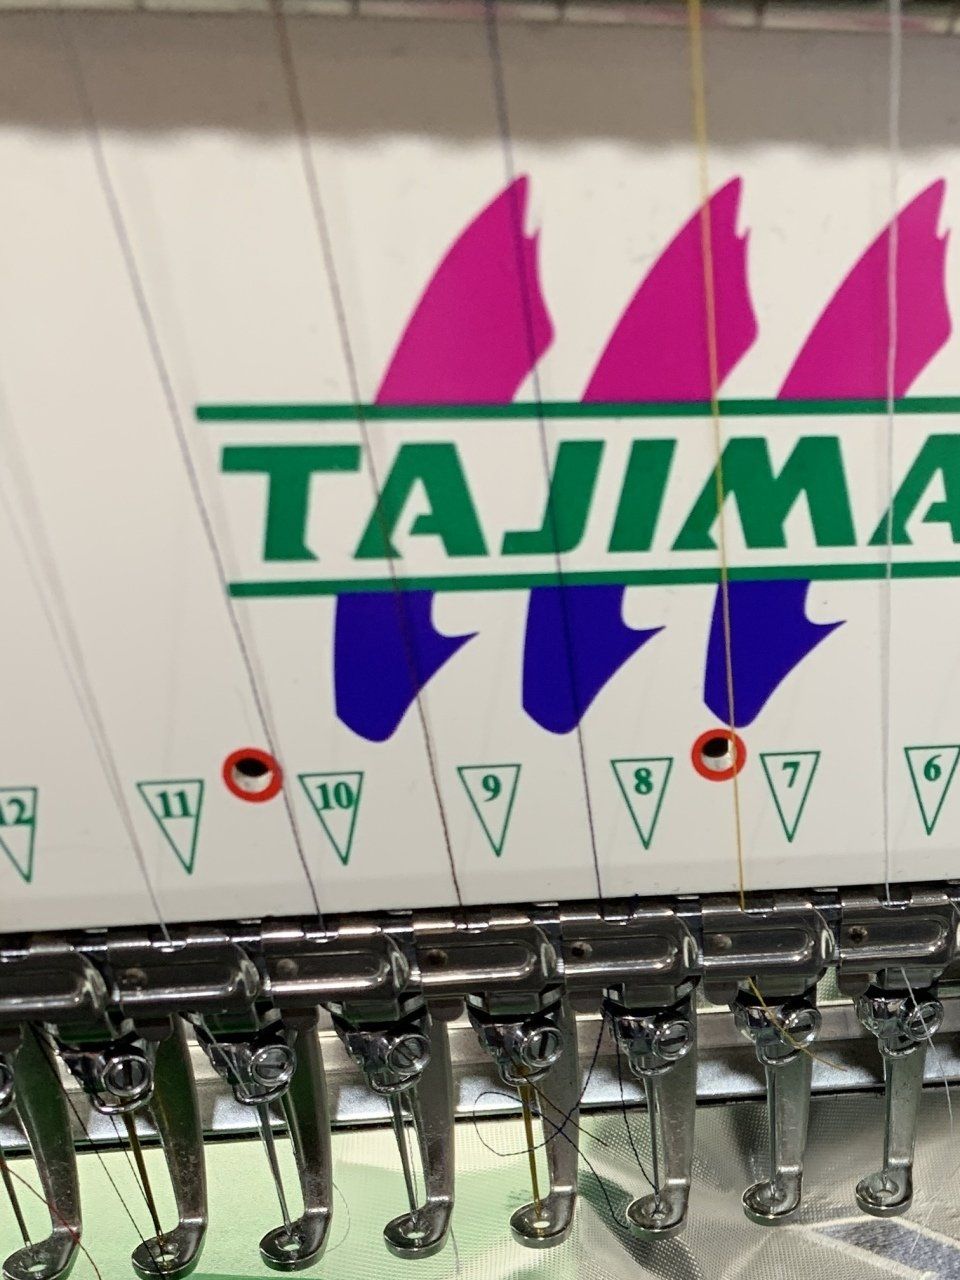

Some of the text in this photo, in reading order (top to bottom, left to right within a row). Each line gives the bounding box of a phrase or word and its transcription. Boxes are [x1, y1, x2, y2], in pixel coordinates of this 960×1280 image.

[634, 767, 654, 795] 8
[782, 761, 800, 788] 7
[923, 755, 942, 781] 6
[318, 781, 355, 811] 10
[482, 775, 502, 801] 9
[158, 791, 194, 818] 11
